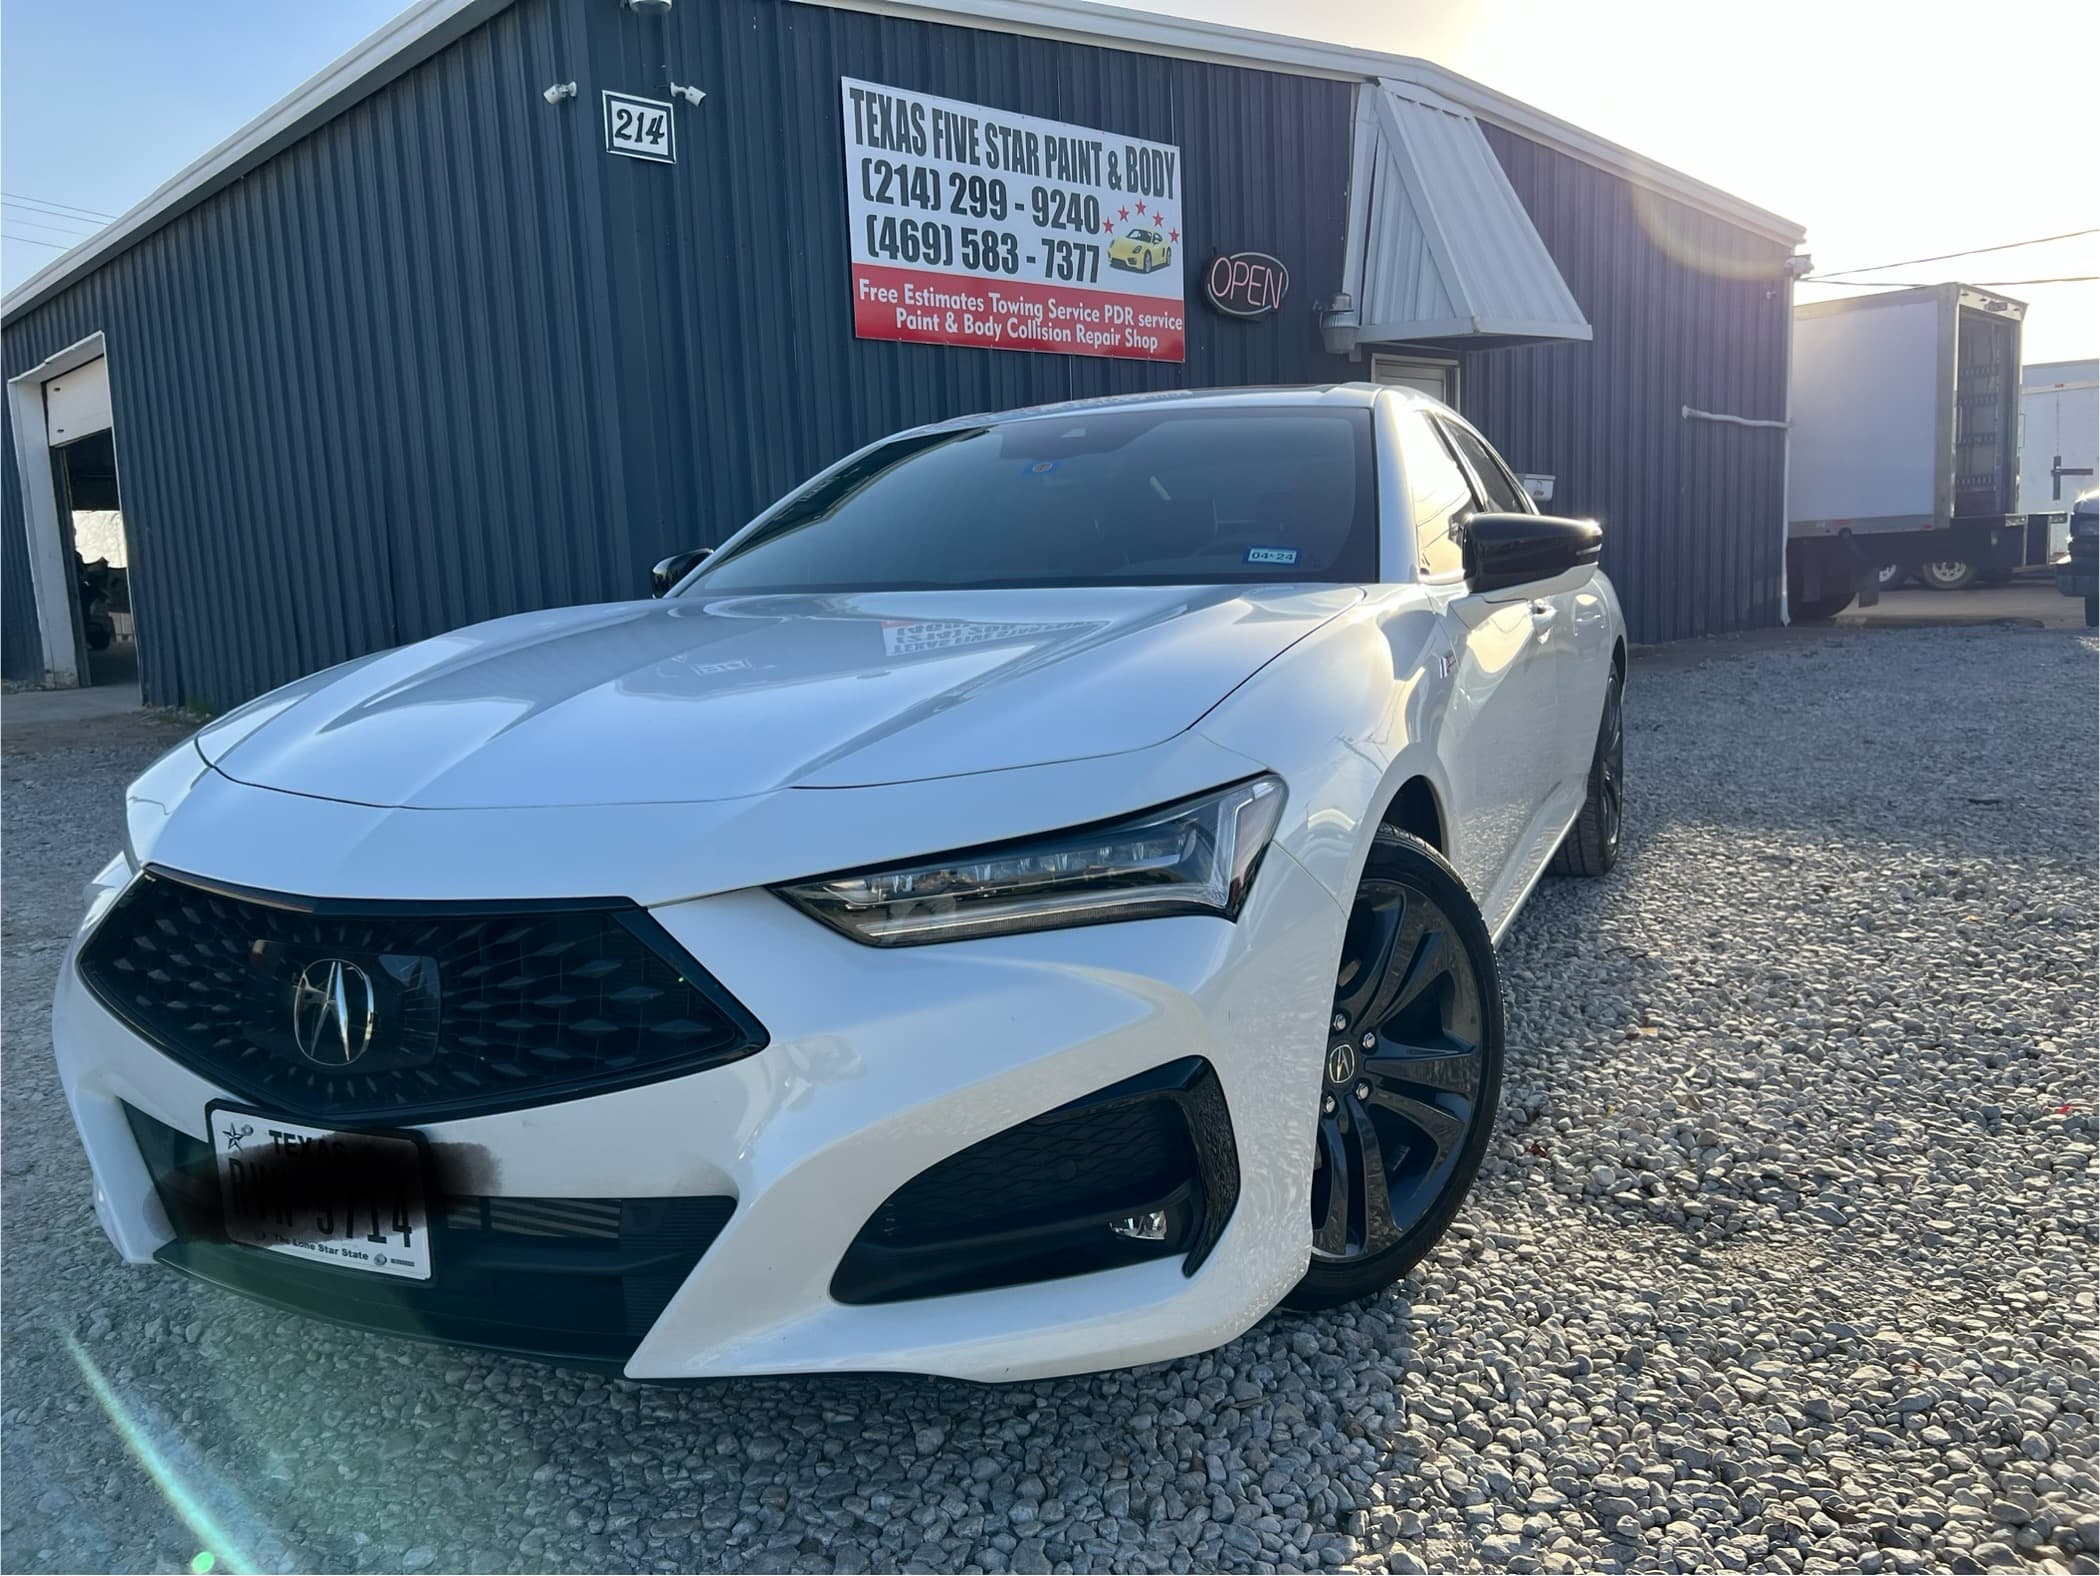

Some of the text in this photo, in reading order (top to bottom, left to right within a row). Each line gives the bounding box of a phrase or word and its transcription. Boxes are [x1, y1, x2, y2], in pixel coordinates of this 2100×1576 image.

[614, 108, 665, 145] 214
[849, 87, 1175, 200] TEXAS FIVE STAR PAINT & BODY
[861, 157, 941, 211] (214)
[948, 172, 1008, 221] 299
[1031, 186, 1101, 235] 9240
[866, 214, 953, 267] (469)
[960, 226, 1019, 275] 583
[1041, 238, 1100, 284] 7377
[859, 278, 1183, 331] Free Estimates Towing Service PDR service
[1211, 257, 1283, 309] OPEN
[896, 307, 1158, 353] Paint & Body Collision Repair Shop
[318, 1244, 339, 1255] Star
[341, 1248, 369, 1260] State
